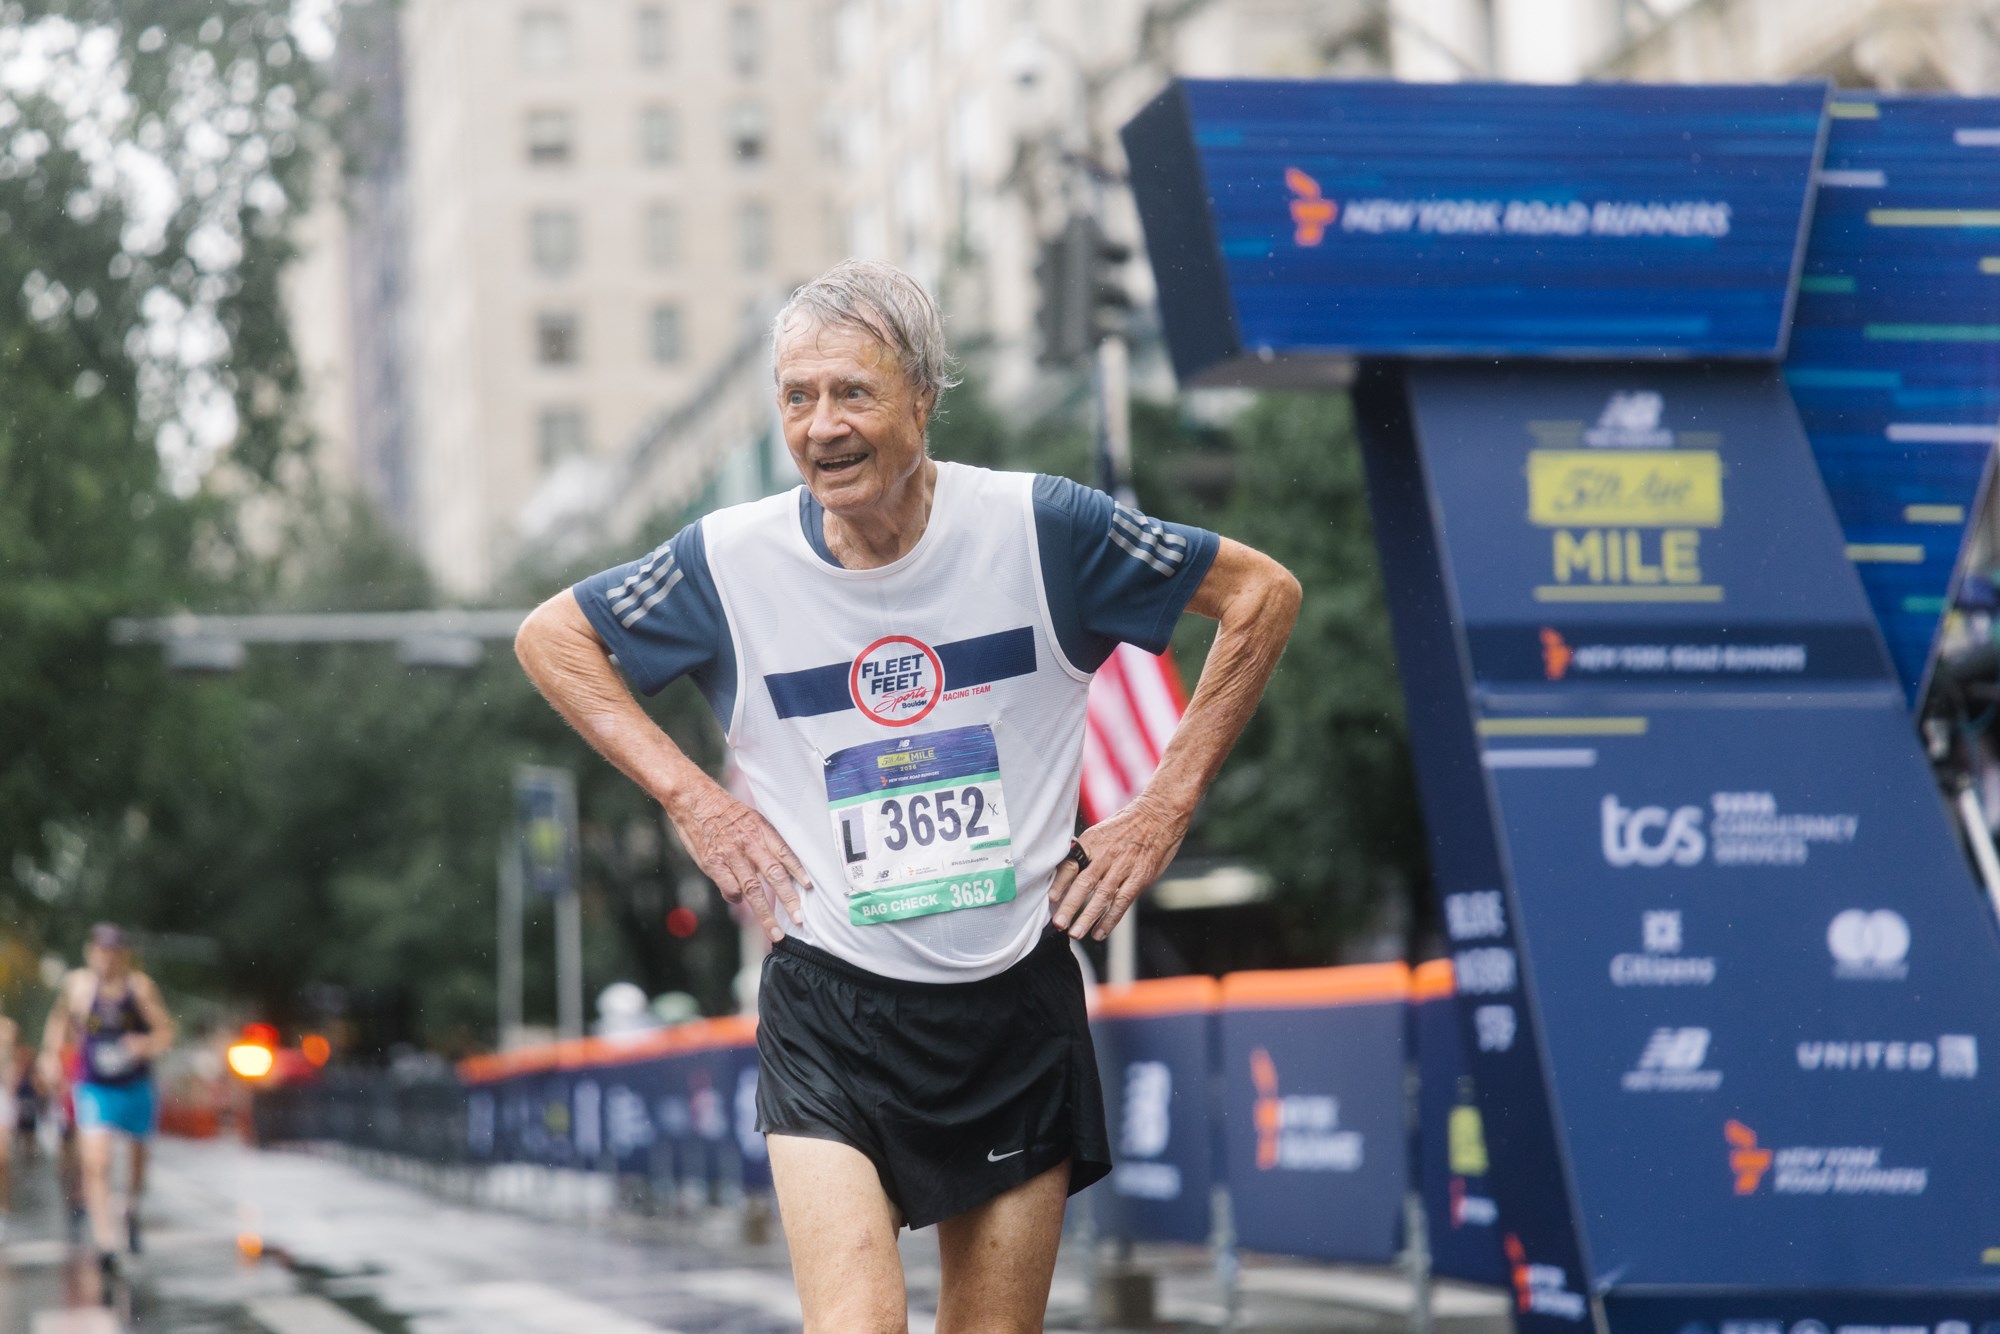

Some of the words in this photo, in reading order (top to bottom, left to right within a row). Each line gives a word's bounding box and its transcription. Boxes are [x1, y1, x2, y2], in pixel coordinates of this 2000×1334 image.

[1342, 200, 1414, 234] NEW
[1417, 200, 1499, 235] YORK
[1503, 201, 1589, 236] ROAD
[1590, 201, 1732, 237] RUNNERS
[1552, 529, 1702, 583] MILE
[862, 653, 924, 679] FLEET
[871, 671, 922, 695] FEET
[942, 690, 970, 702] RACING
[972, 685, 991, 698] TEAM
[873, 686, 933, 714] Sports
[901, 699, 928, 709] Boulder
[910, 749, 935, 761] MILE
[880, 786, 990, 851] 3652
[1601, 793, 1706, 868] tcs
[842, 820, 867, 863] L
[861, 902, 887, 917] BAG
[891, 893, 939, 911] CHECK
[949, 878, 997, 908] 3652
[1796, 1041, 1934, 1070] UNITED
